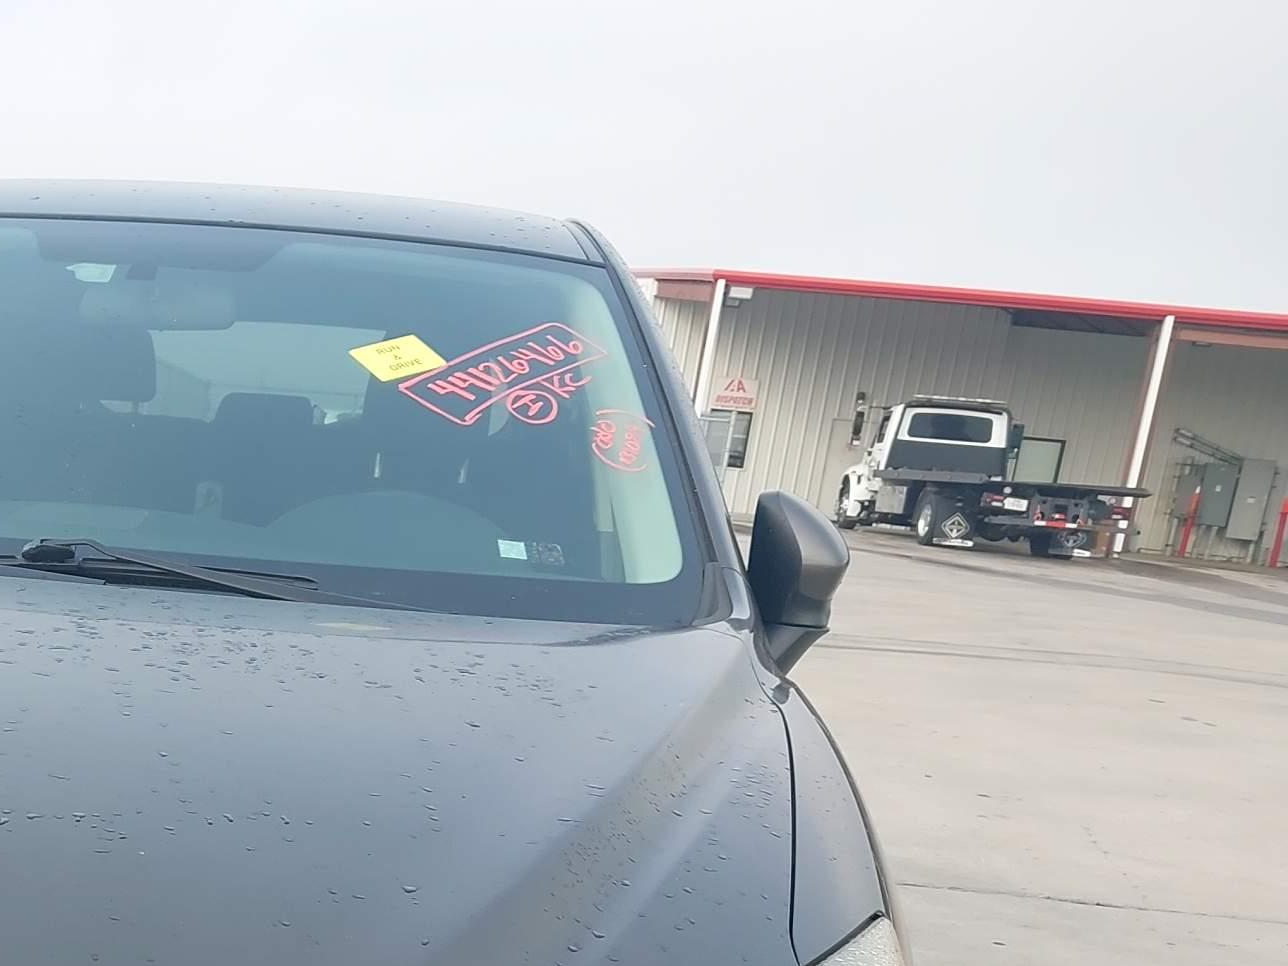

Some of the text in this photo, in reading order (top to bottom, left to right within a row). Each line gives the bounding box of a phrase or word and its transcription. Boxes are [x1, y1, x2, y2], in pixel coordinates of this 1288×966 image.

[376, 345, 400, 354] RUN
[389, 358, 423, 371] DRIVE
[427, 335, 583, 400] 44126466
